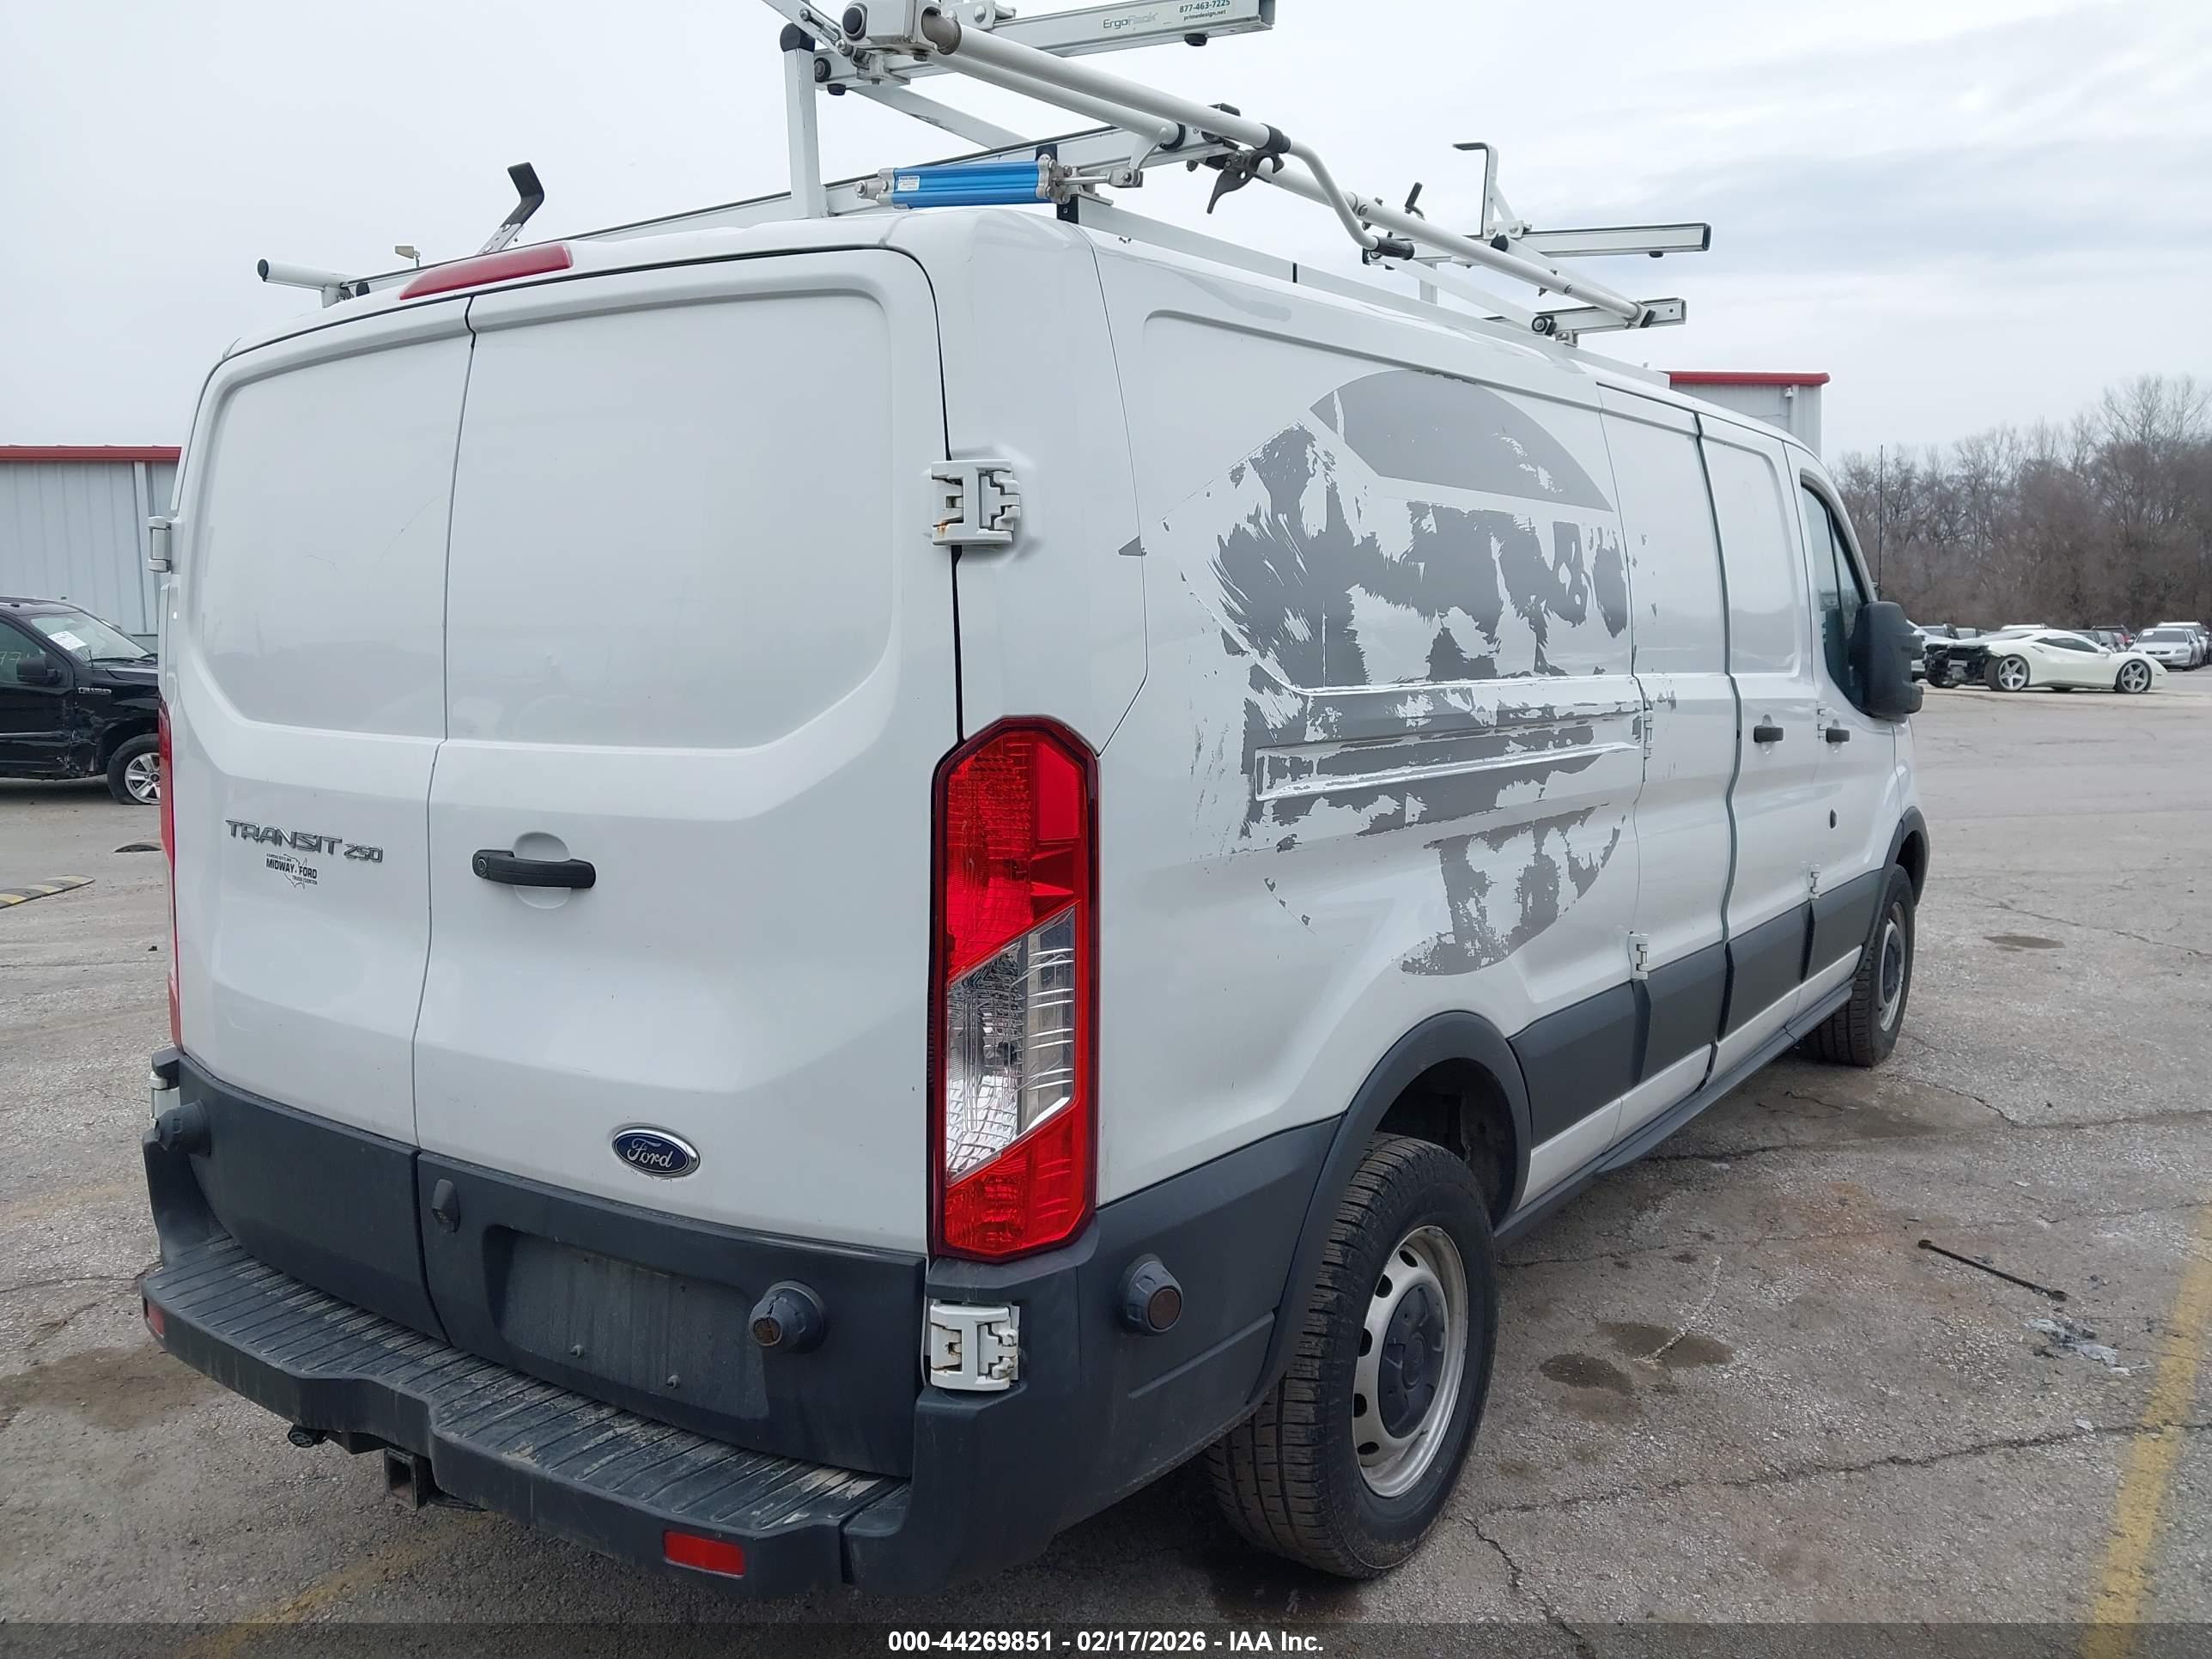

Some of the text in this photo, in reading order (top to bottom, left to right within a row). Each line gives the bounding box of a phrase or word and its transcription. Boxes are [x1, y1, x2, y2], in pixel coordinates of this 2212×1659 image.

[1179, 0, 1231, 13] 877-463-7225
[1183, 9, 1226, 21] primedesign.net
[226, 819, 384, 863] TRANSIT 250
[266, 858, 318, 879] MIDWAY FORD
[627, 1138, 673, 1168] Ford
